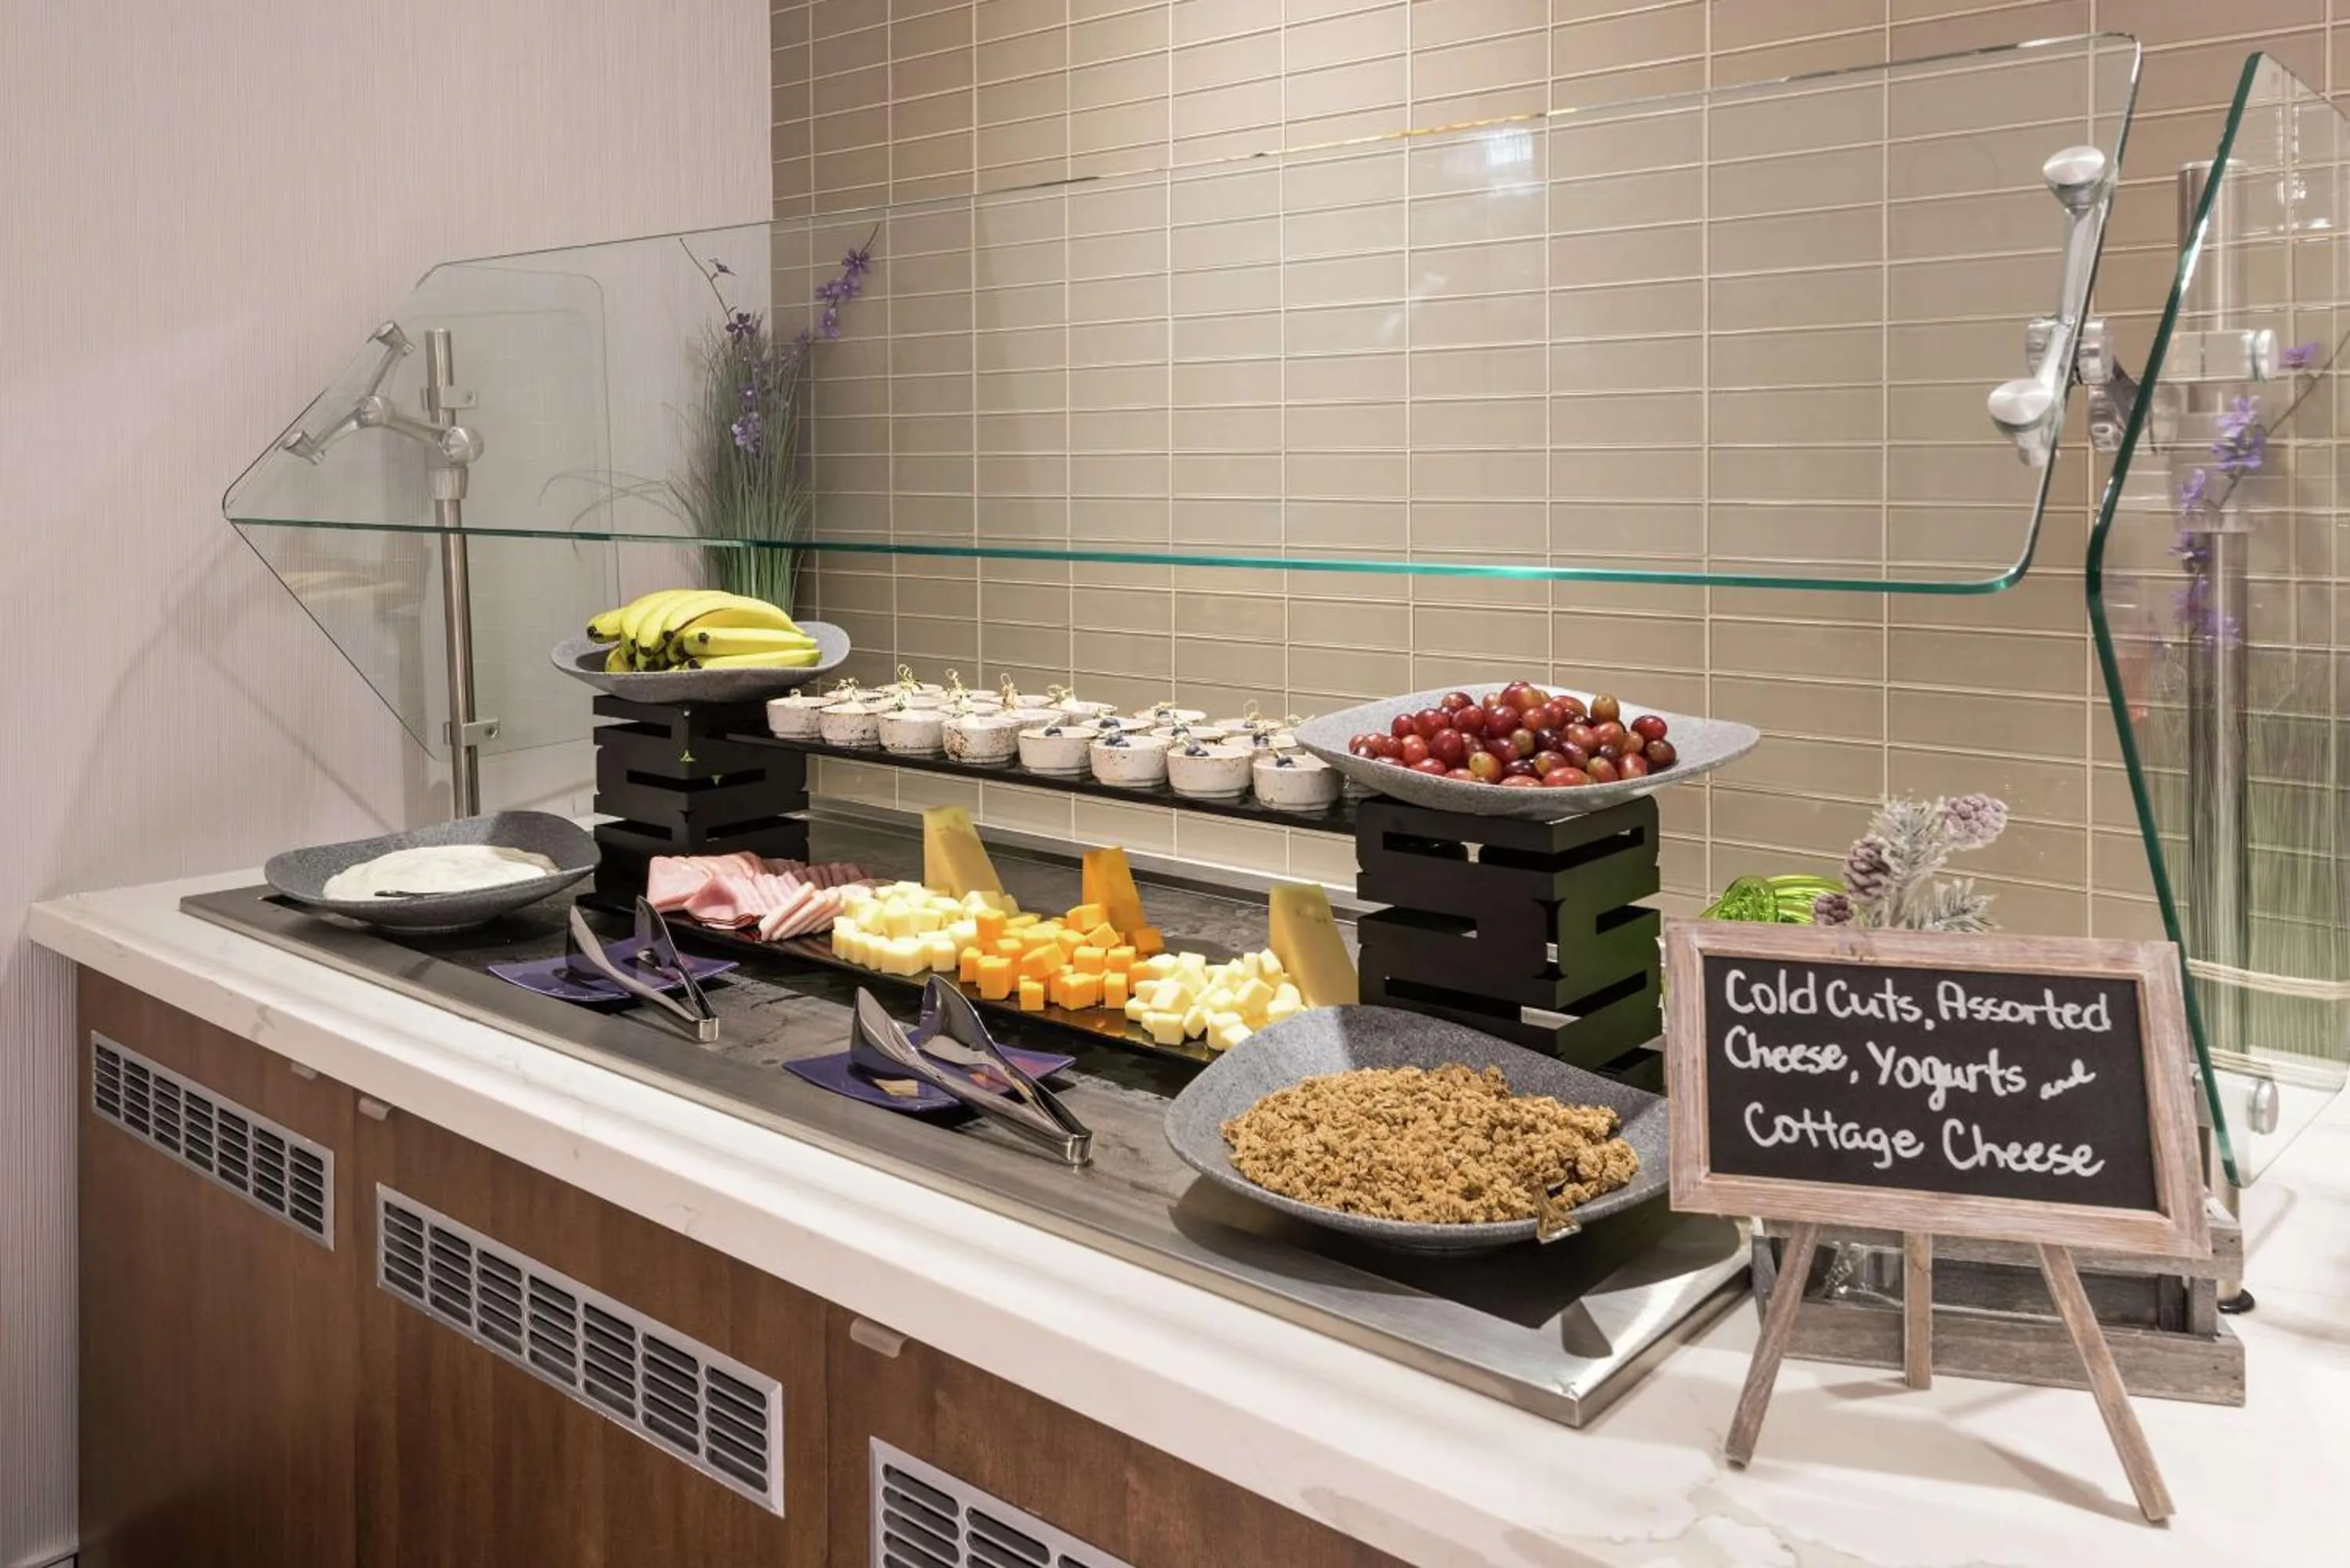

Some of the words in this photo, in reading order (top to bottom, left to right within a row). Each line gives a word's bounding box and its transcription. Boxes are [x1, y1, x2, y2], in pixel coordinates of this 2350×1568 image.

[1725, 969, 1818, 1015] Cold
[1825, 977, 1935, 1031] Cuts,
[1937, 980, 2113, 1032] Assorted
[1724, 1024, 1860, 1085] Cheese,
[1866, 1041, 2027, 1111] Yogurts
[2040, 1059, 2096, 1100] and
[1744, 1101, 1925, 1169] Cottage
[1942, 1118, 2106, 1177] Cheese
